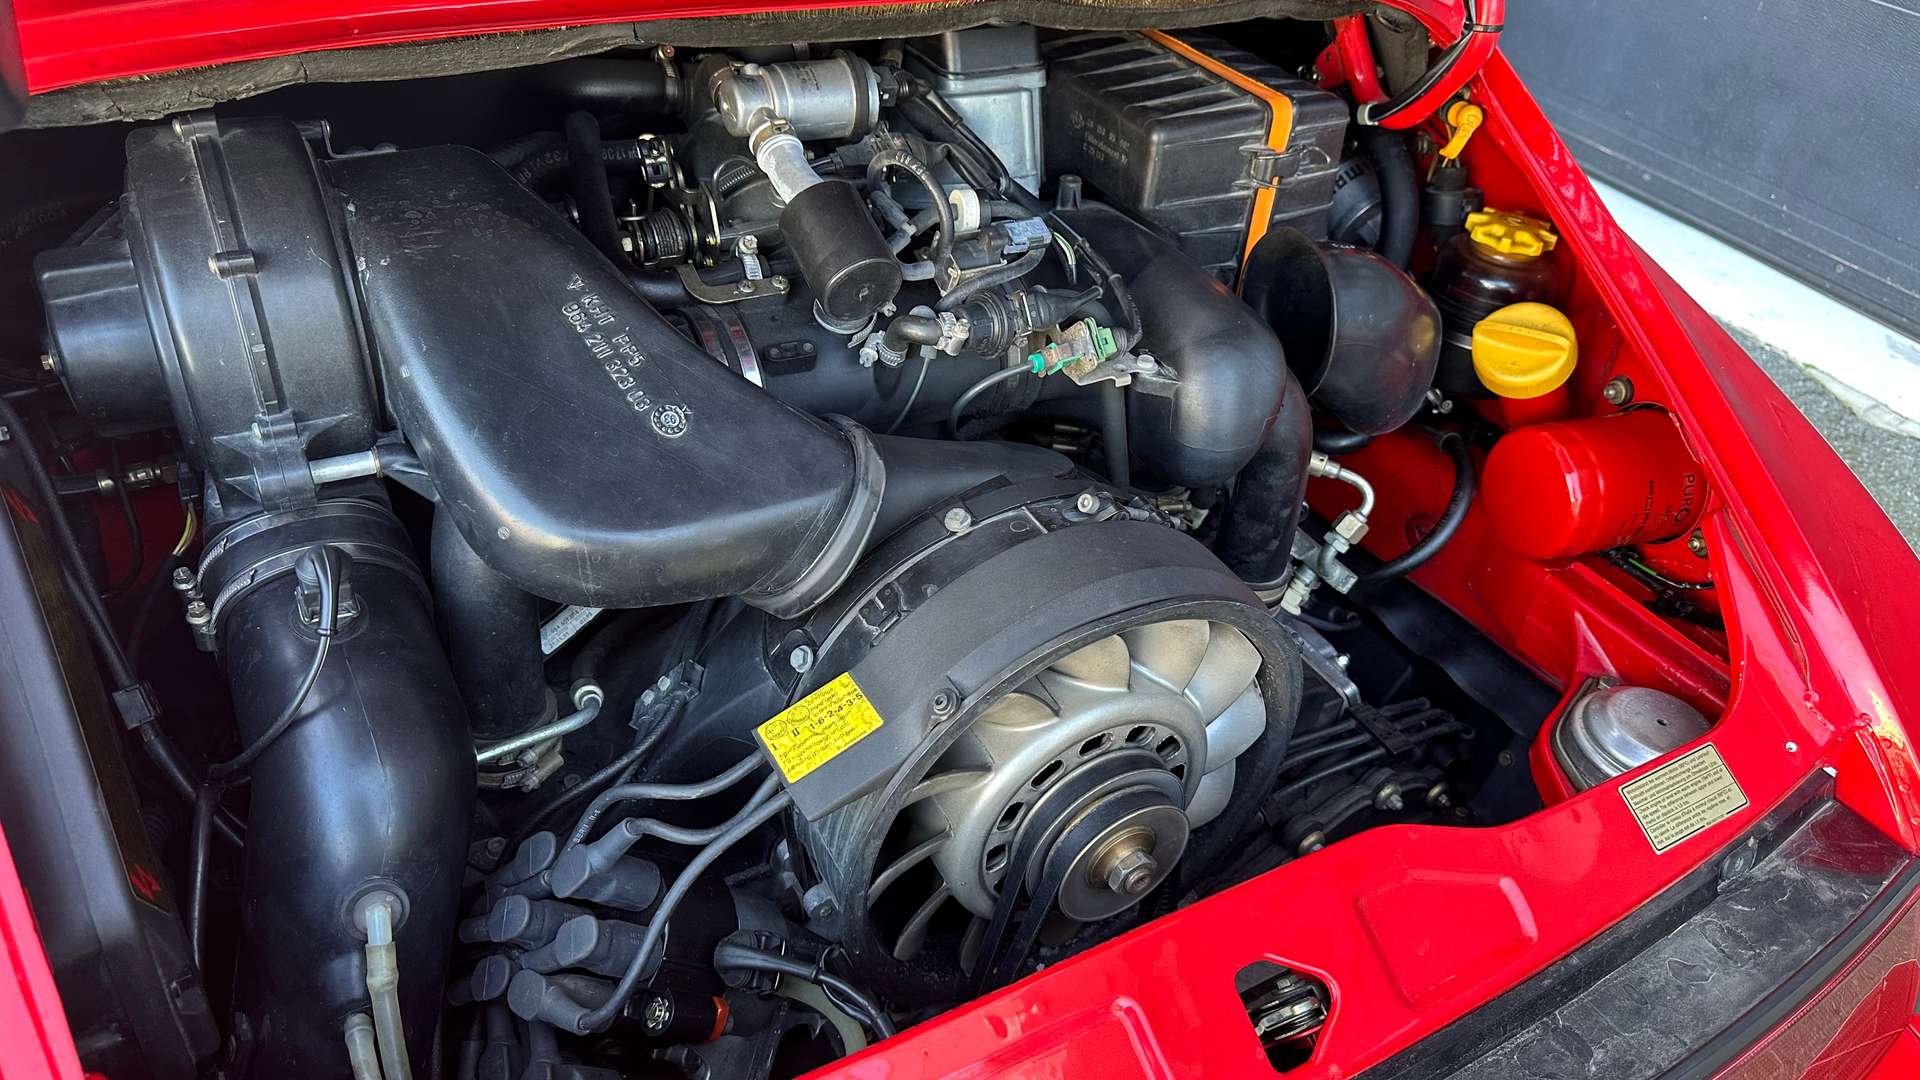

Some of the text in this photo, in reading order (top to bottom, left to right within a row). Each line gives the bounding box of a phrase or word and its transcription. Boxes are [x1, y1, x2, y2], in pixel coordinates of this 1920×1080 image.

[561, 302, 652, 412] 964 211 323 03
[809, 692, 863, 730] 1-6-2-4-3-5
